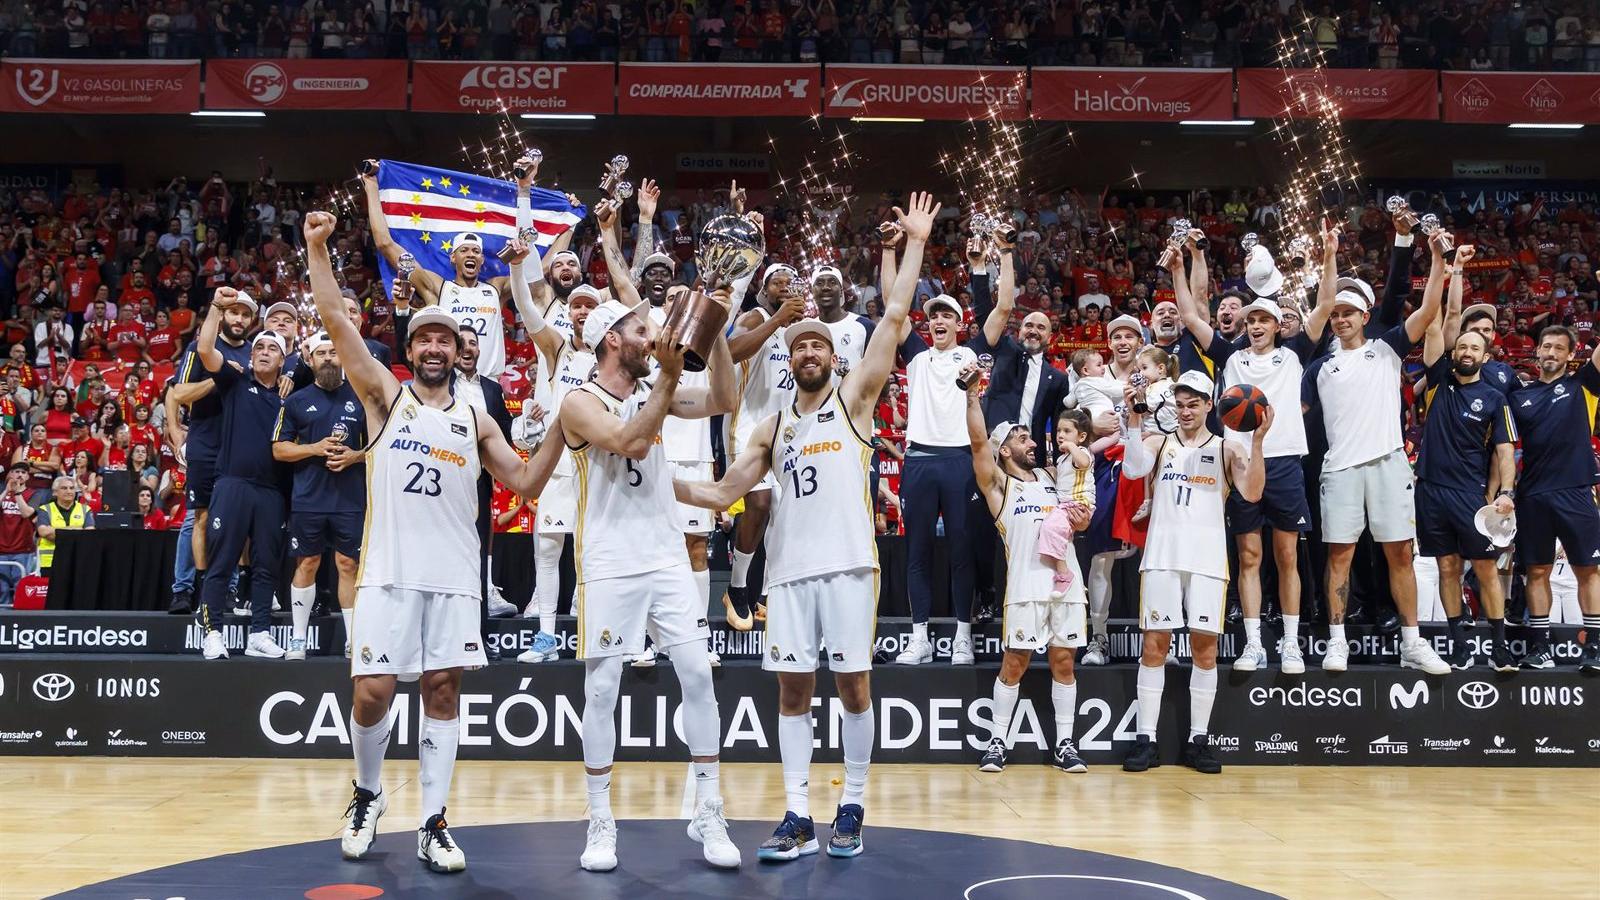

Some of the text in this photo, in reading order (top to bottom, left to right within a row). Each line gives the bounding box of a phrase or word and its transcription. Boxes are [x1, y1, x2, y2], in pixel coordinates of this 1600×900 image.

[300, 78, 361, 89] INGENIERÍA
[481, 66, 567, 89] caser
[64, 79, 183, 92] V2 GASOLINERAS
[629, 83, 782, 98] COMPRALAENTRADA
[863, 84, 1020, 105] GRUPOSURESTE
[459, 95, 566, 110] Grupo Helvetia
[1151, 100, 1191, 116] viajes
[681, 157, 765, 168] Grada Norte
[1504, 163, 1540, 174] Norte
[451, 306, 497, 315] AUTOHERO
[777, 368, 795, 391] 28
[389, 438, 467, 468] AUTOHERO
[403, 461, 443, 497] 23
[626, 457, 643, 488] 5
[1161, 472, 1217, 486] AUTOHERO
[792, 465, 818, 499] 13
[1177, 485, 1192, 507] 11
[1556, 563, 1564, 576] 7
[97, 678, 160, 698] IONOS
[1249, 682, 1362, 707] endesa
[1521, 686, 1584, 706] IONOS
[0, 731, 34, 740] ransaher
[161, 731, 206, 740] ONEBOX
[1315, 734, 1346, 746] renfe
[1423, 738, 1462, 747] Transaher
[1255, 741, 1299, 752] SPALDING
[1368, 745, 1408, 754] LOTUS
